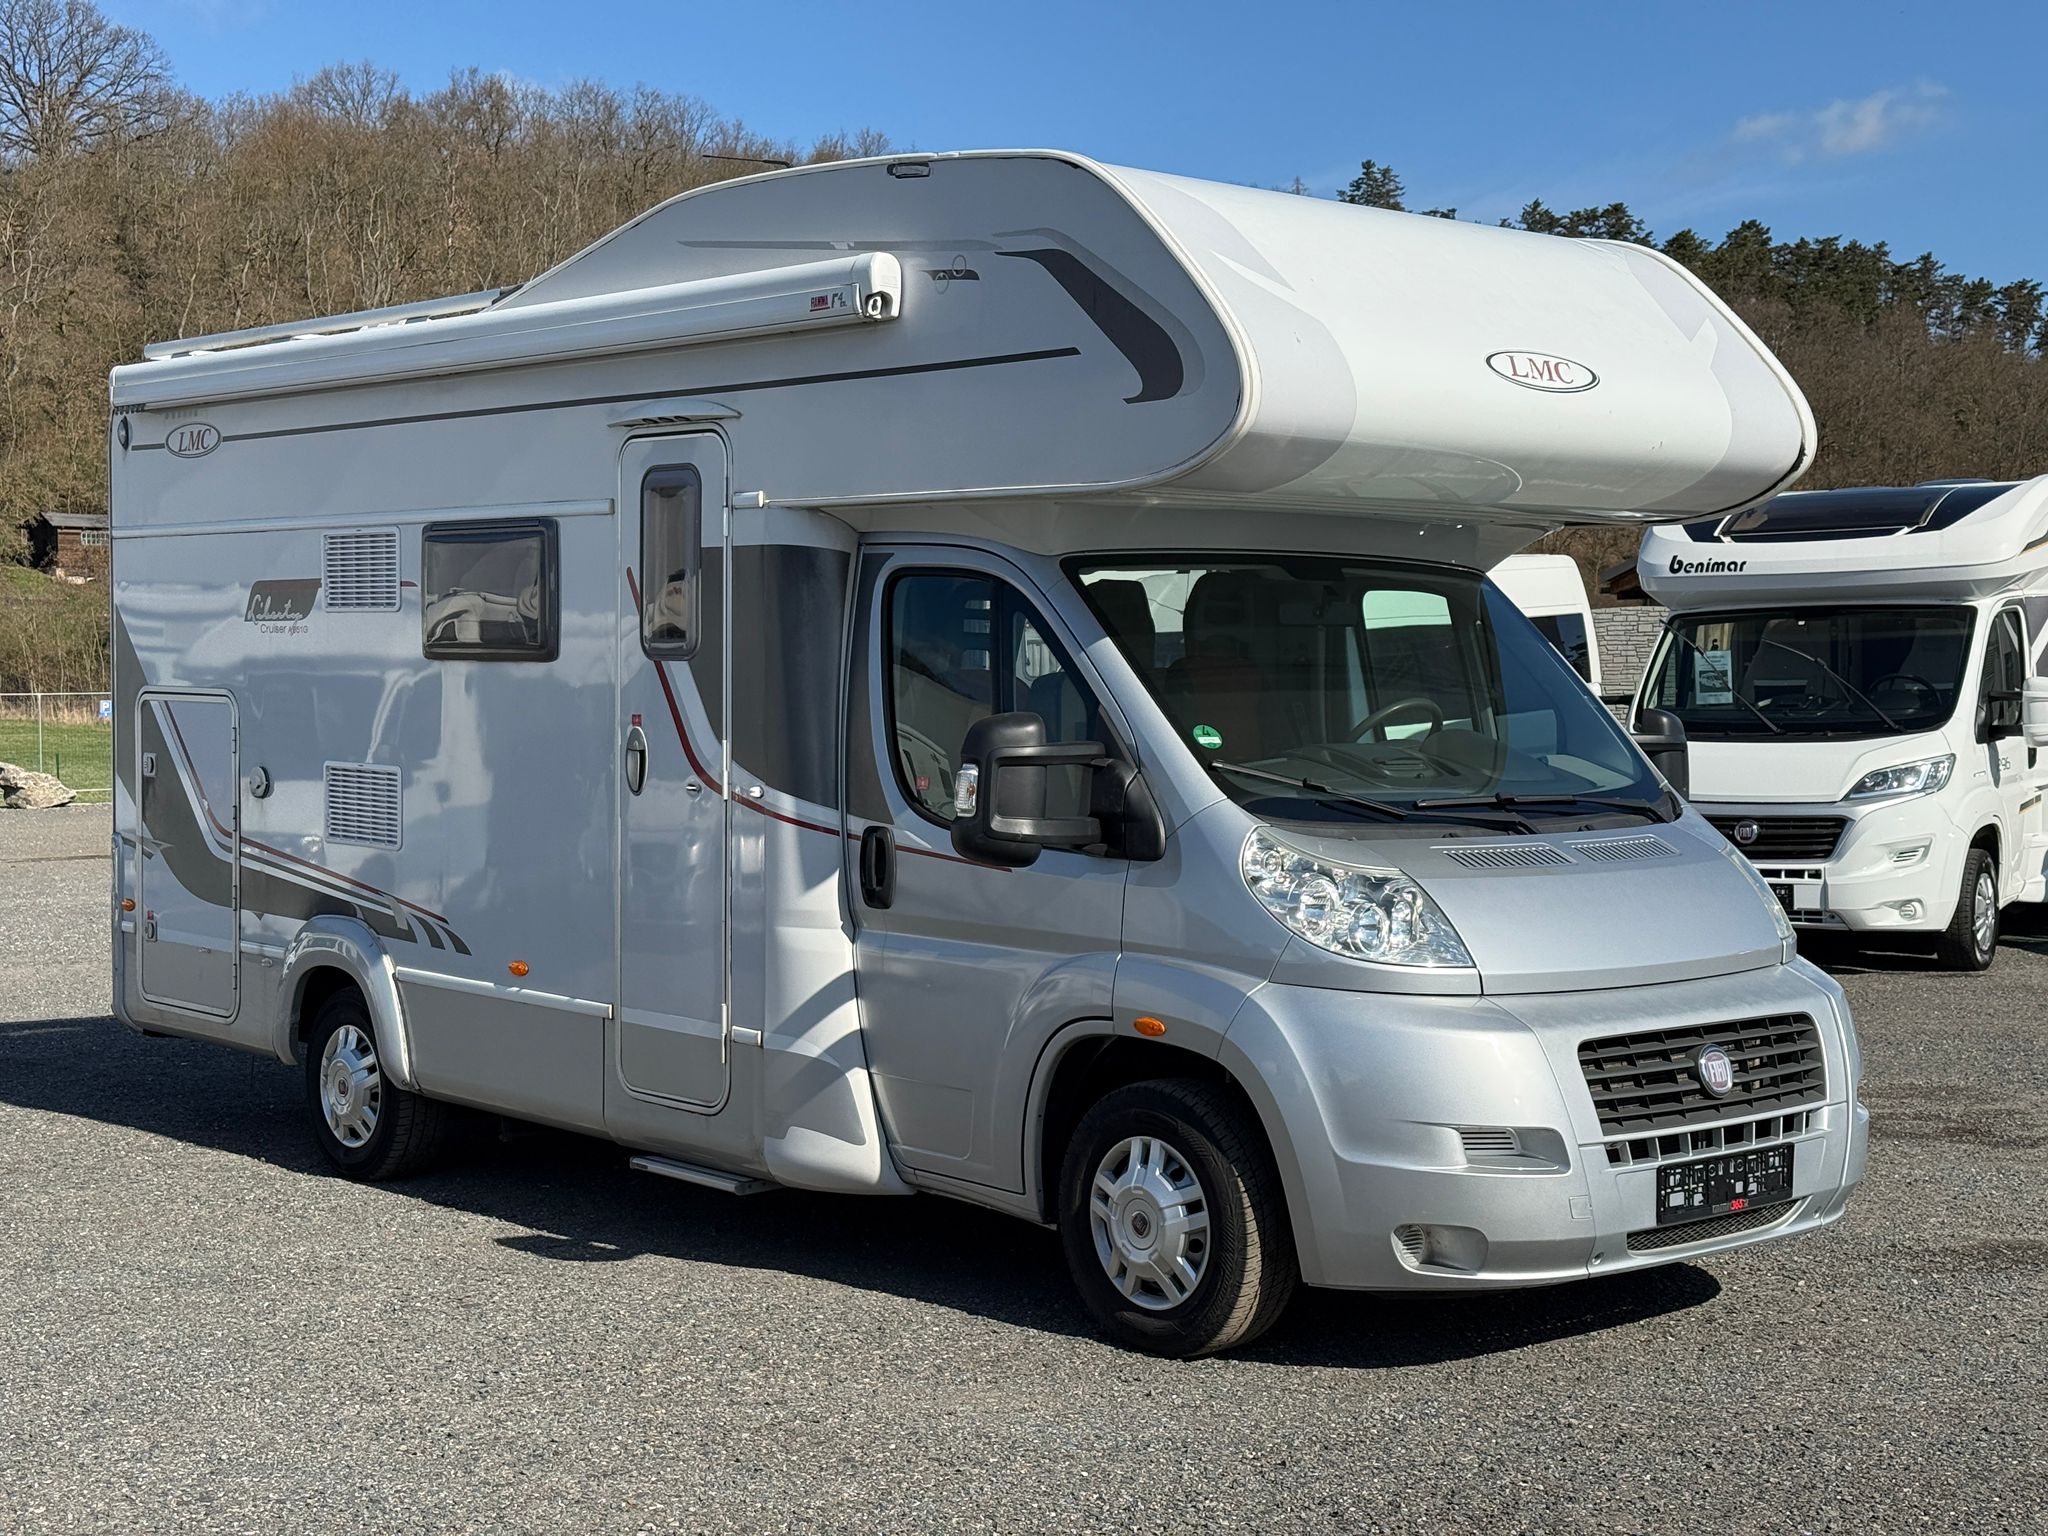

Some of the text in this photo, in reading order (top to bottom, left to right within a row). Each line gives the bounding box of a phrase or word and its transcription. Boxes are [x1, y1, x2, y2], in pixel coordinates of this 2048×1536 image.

[1505, 354, 1574, 385] LMC
[178, 428, 212, 452] LMC
[1668, 554, 1747, 574] benimar
[260, 623, 287, 634] Cruiser
[102, 701, 111, 713] P
[1201, 725, 1211, 737] 4
